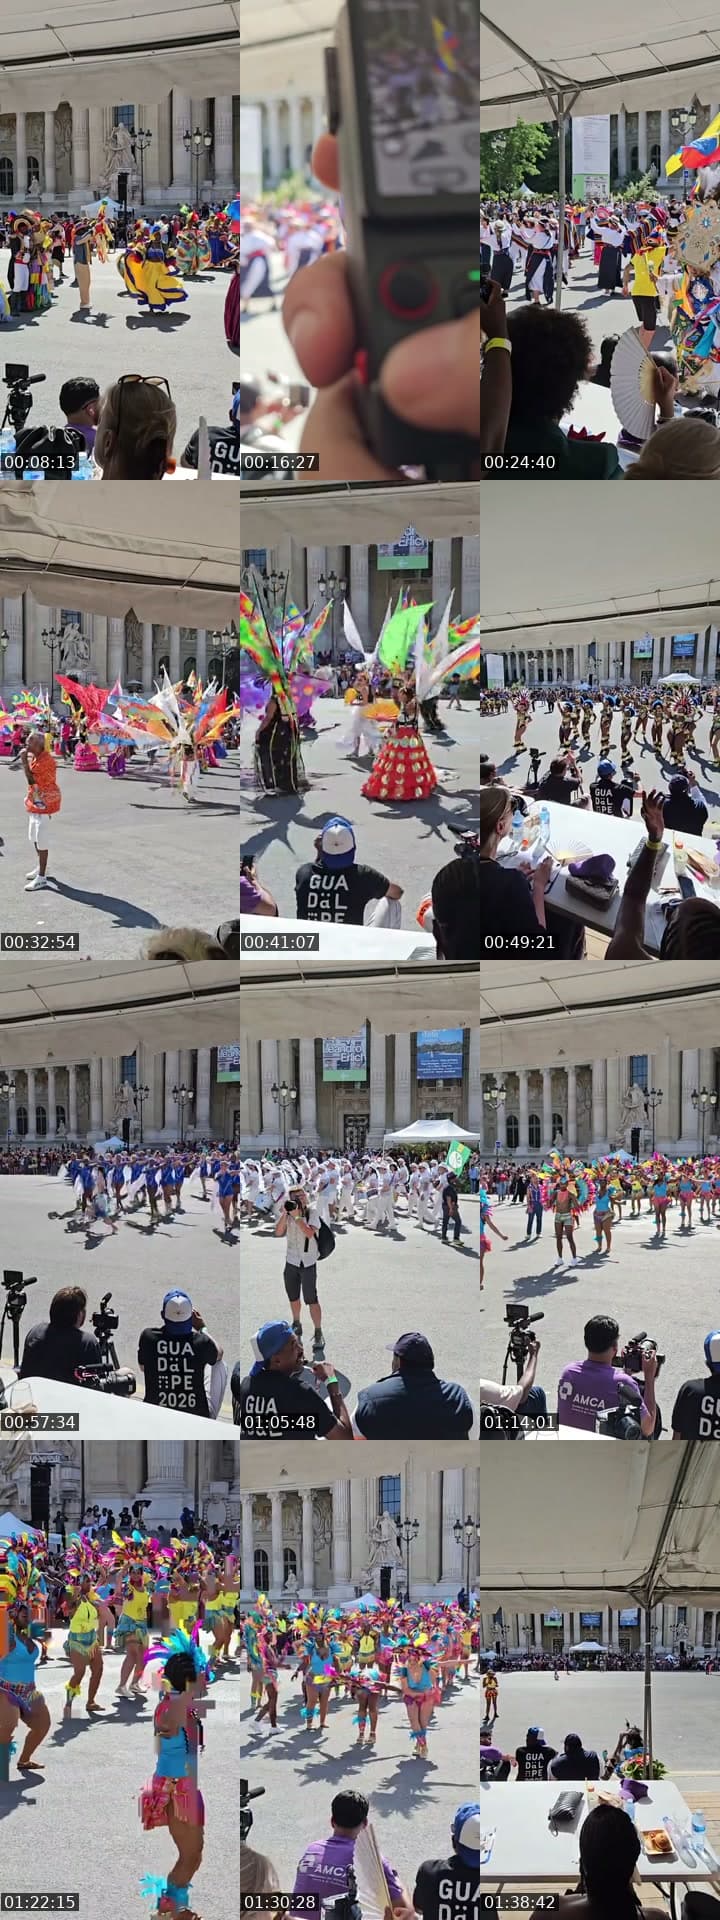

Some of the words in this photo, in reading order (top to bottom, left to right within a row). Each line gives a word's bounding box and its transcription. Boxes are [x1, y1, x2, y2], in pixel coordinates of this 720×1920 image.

[595, 788, 613, 797] GUA
[309, 874, 349, 891] GUA
[157, 1339, 195, 1356] GUA
[158, 1391, 197, 1408] 2026
[245, 1395, 278, 1414] GUA
[572, 1393, 605, 1409] AMCA
[525, 1752, 545, 1761] GUA
[314, 1864, 347, 1878] AMC
